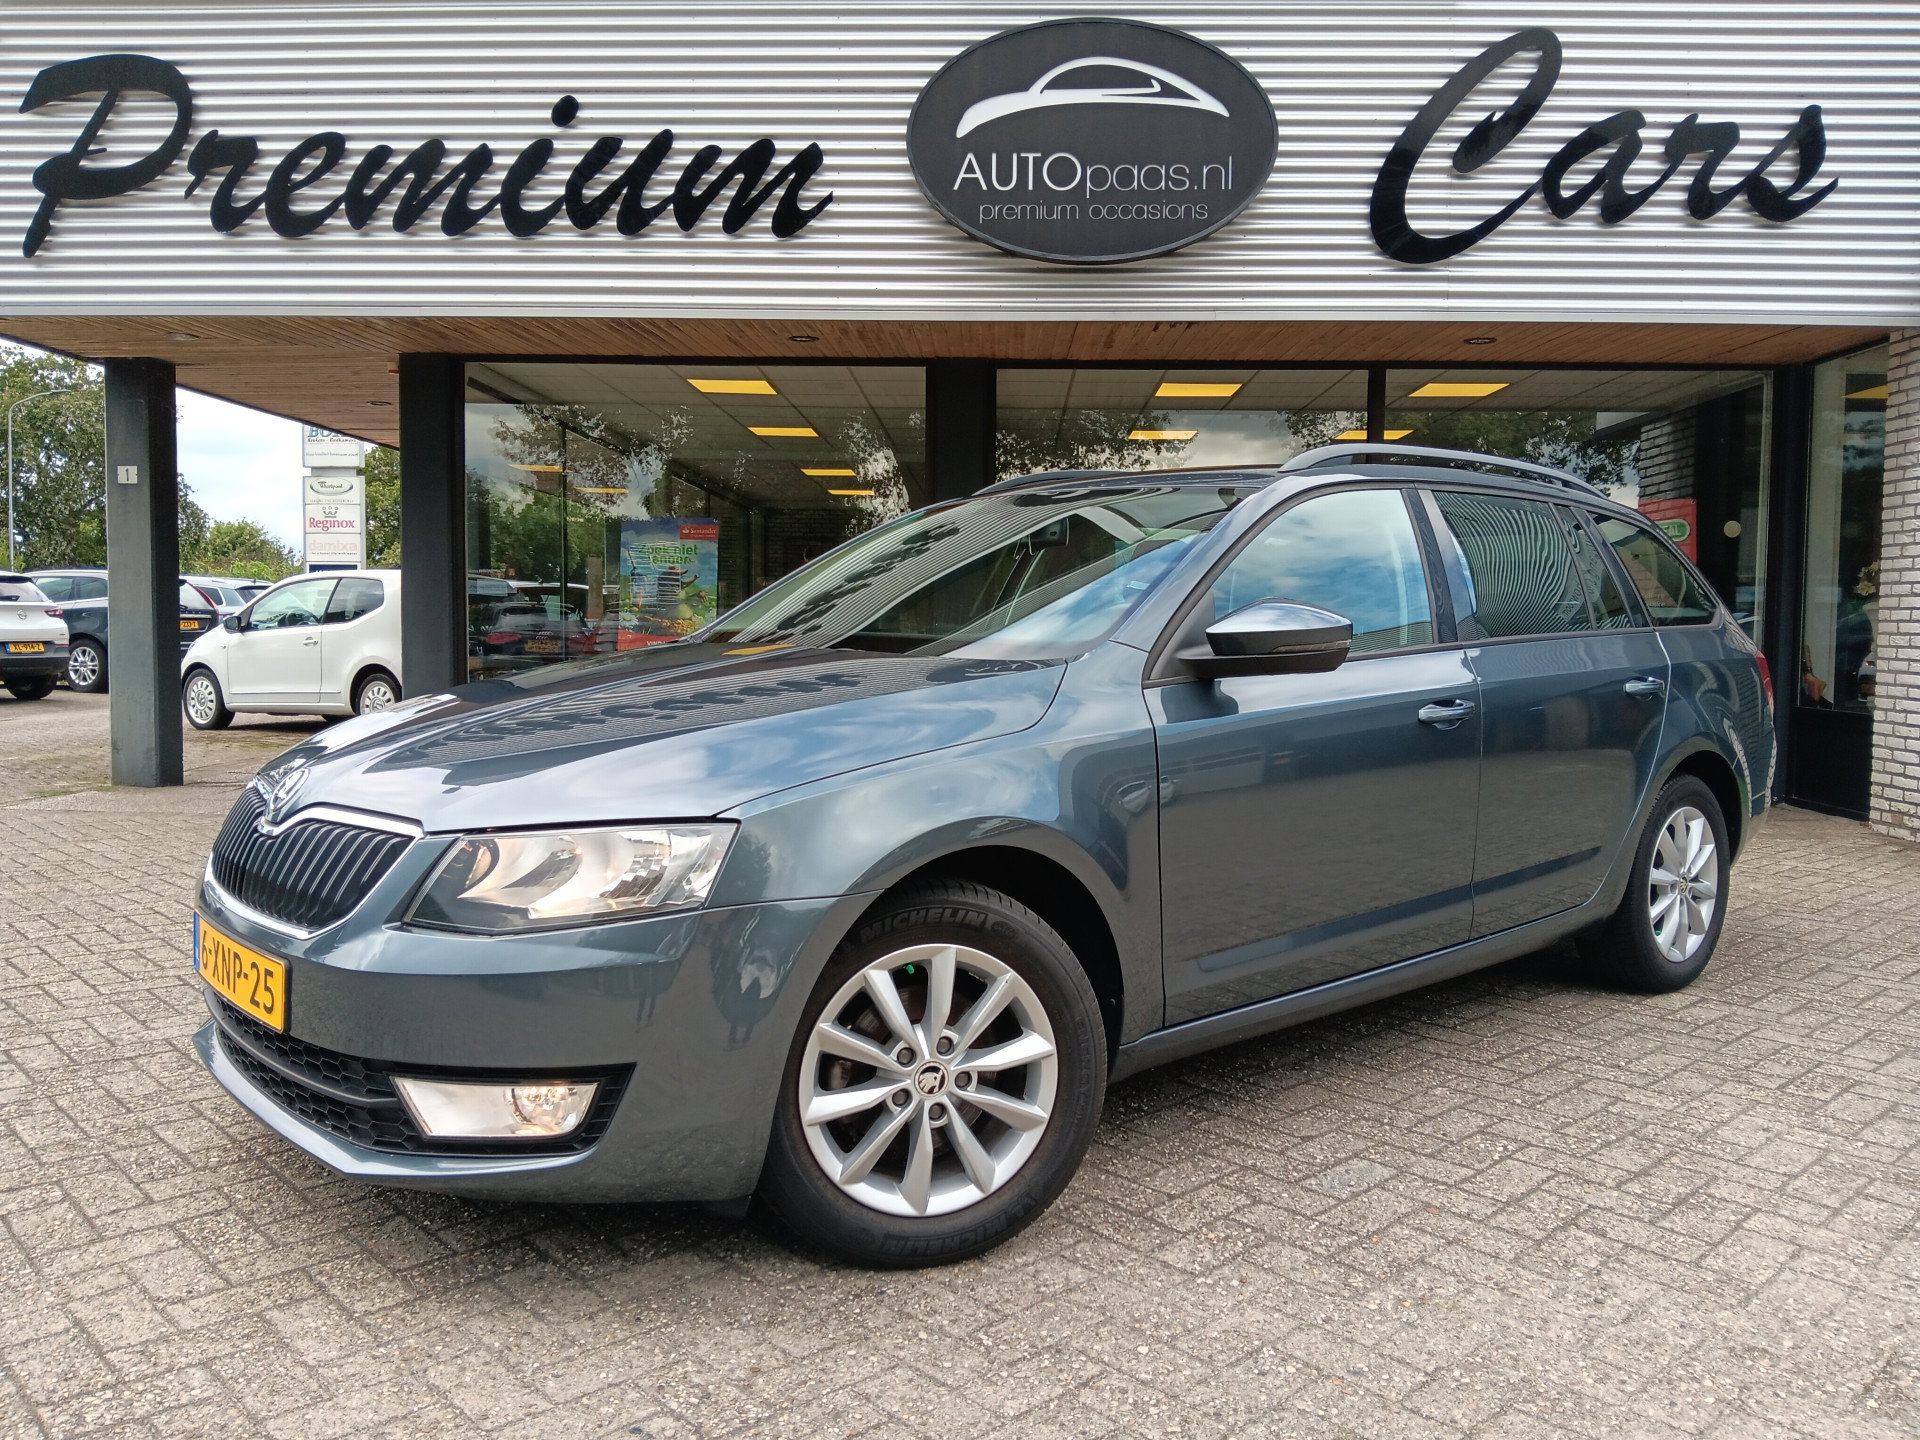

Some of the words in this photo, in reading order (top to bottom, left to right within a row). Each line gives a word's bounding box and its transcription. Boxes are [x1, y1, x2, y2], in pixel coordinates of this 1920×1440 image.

[19, 53, 834, 258] Premium
[1369, 27, 1839, 264] Cars
[953, 152, 1233, 198] AUTOpaas.nl
[979, 200, 1079, 224] premium
[1089, 200, 1208, 220] occasions
[309, 517, 355, 531] Reginox
[860, 907, 992, 944] MICHELIN
[201, 930, 275, 1015] 6-XNP-25
